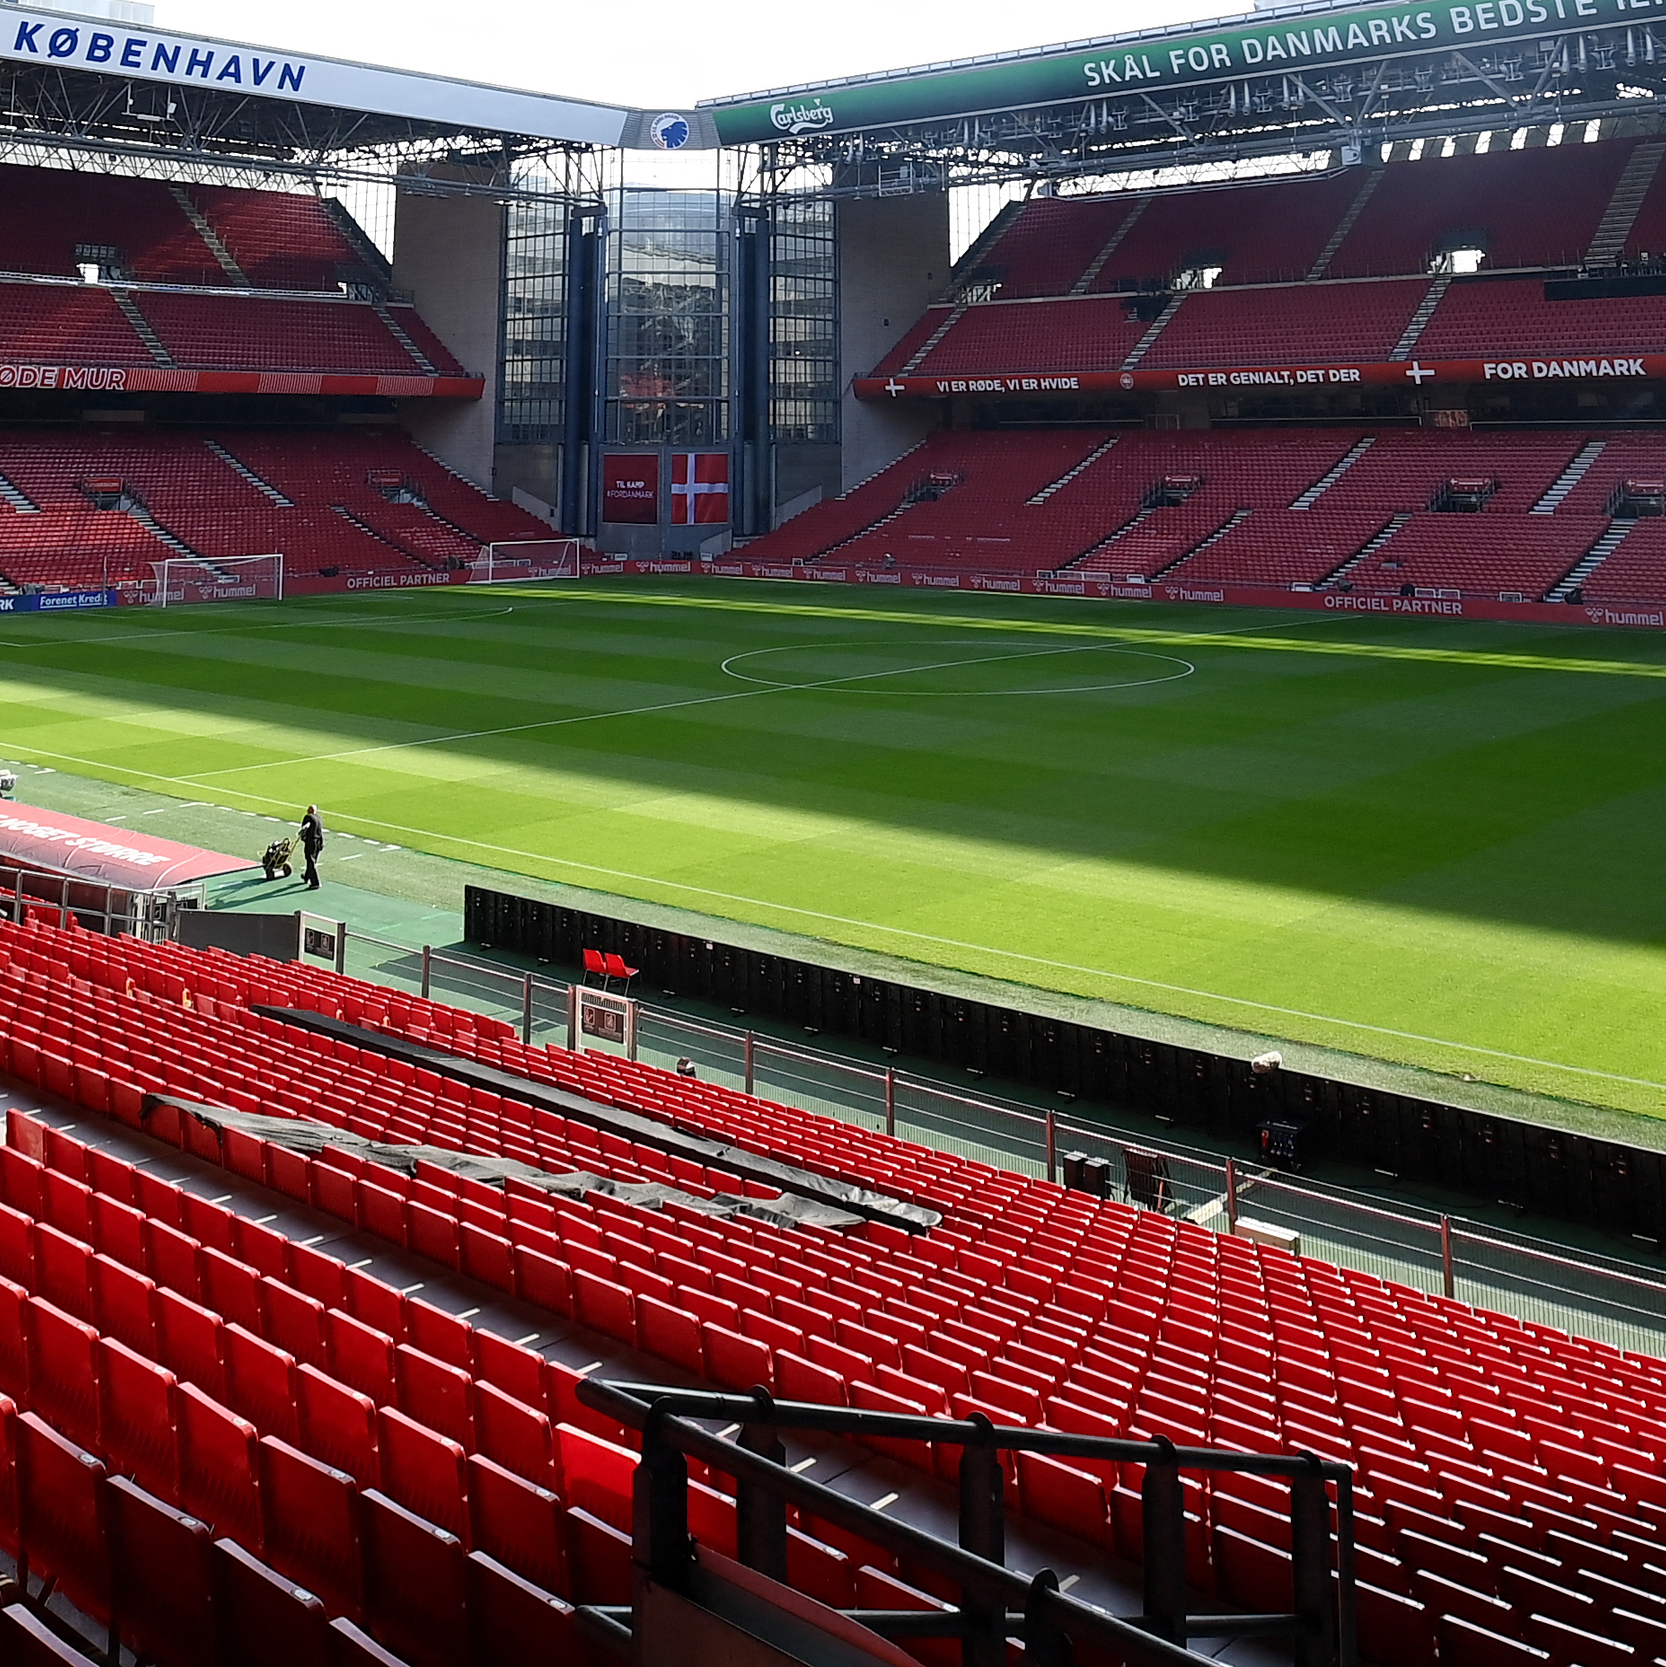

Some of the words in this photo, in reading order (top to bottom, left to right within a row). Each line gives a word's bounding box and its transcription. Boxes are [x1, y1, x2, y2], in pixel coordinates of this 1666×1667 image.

[14, 20, 305, 92] KØBENHAVN
[1083, 50, 1161, 87] SKÅL
[1169, 43, 1230, 76] FOR
[1245, 13, 1437, 65] DANMARKS
[770, 101, 834, 134] Carlsberg
[1483, 361, 1528, 380] FOR
[1532, 358, 1647, 378] DANMARK
[62, 368, 126, 391] MUR
[936, 381, 951, 392] VI
[952, 381, 966, 392] ER
[1007, 379, 1021, 391] VI
[1022, 379, 1038, 390] ER
[1040, 377, 1079, 390] HVIDE
[1178, 373, 1205, 386] DET
[1208, 372, 1228, 386] ER
[1230, 370, 1294, 387] GENIALT,
[1297, 370, 1325, 383] DET
[1329, 369, 1361, 382] DER
[591, 562, 623, 574] hummel
[650, 561, 691, 573] hummel
[711, 562, 743, 575] hummel
[761, 565, 793, 578] hummel
[347, 575, 397, 589] OFFICIEL
[400, 573, 450, 586] PARTNER
[813, 568, 846, 582] hummel
[866, 571, 900, 584] hummel
[923, 573, 959, 587] hummel
[212, 584, 256, 597] hummel
[983, 577, 1020, 591] hummel
[1045, 580, 1085, 594] hummel
[138, 588, 183, 602] hummel
[1111, 585, 1152, 598] hummel
[1180, 588, 1224, 602] hummel
[39, 595, 77, 607] Forenet
[1324, 595, 1389, 611] OFFICIEL
[1393, 599, 1463, 615] PARTNER
[1605, 610, 1664, 626] hummel
